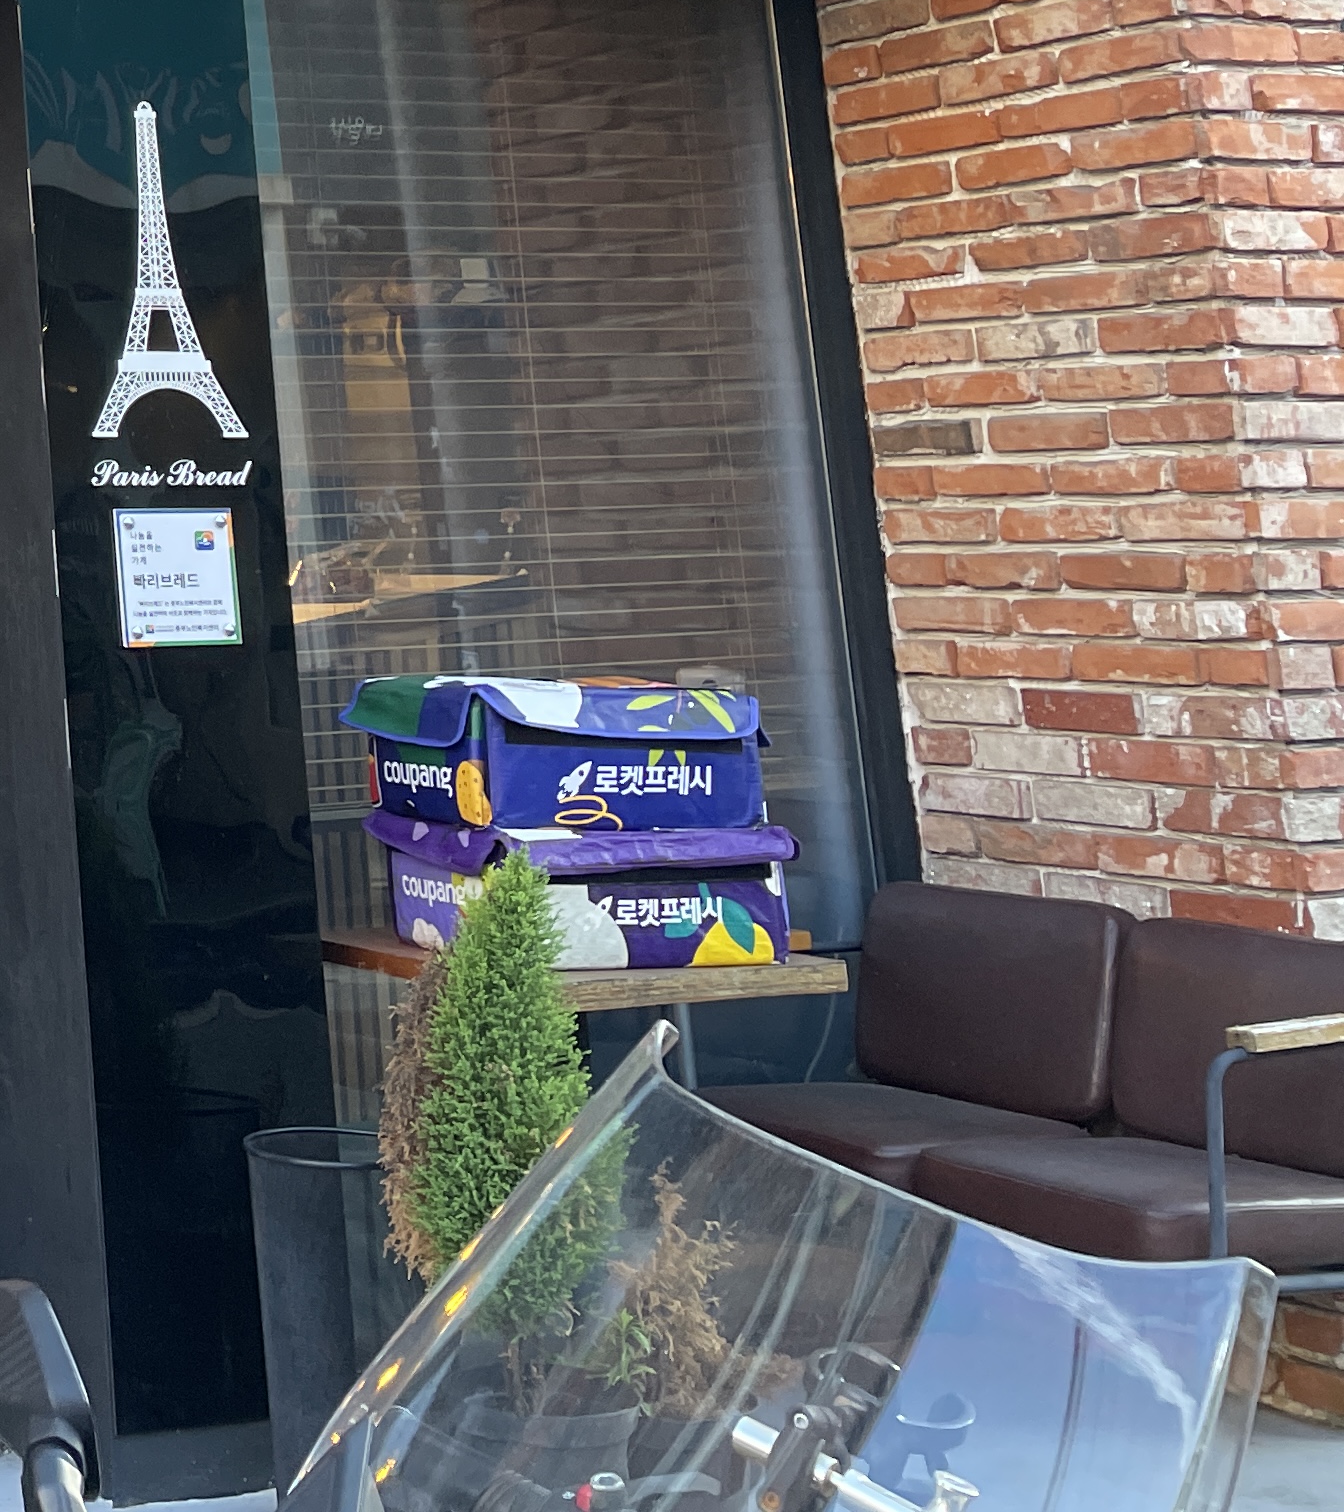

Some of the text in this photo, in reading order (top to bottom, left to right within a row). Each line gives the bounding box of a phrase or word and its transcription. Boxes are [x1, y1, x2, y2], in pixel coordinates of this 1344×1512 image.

[91, 459, 253, 486] Paris Bread
[383, 759, 453, 798] coupang
[593, 765, 712, 796] 로켓프레시
[402, 873, 466, 907] coupang
[616, 896, 723, 928] 로켓프레시
